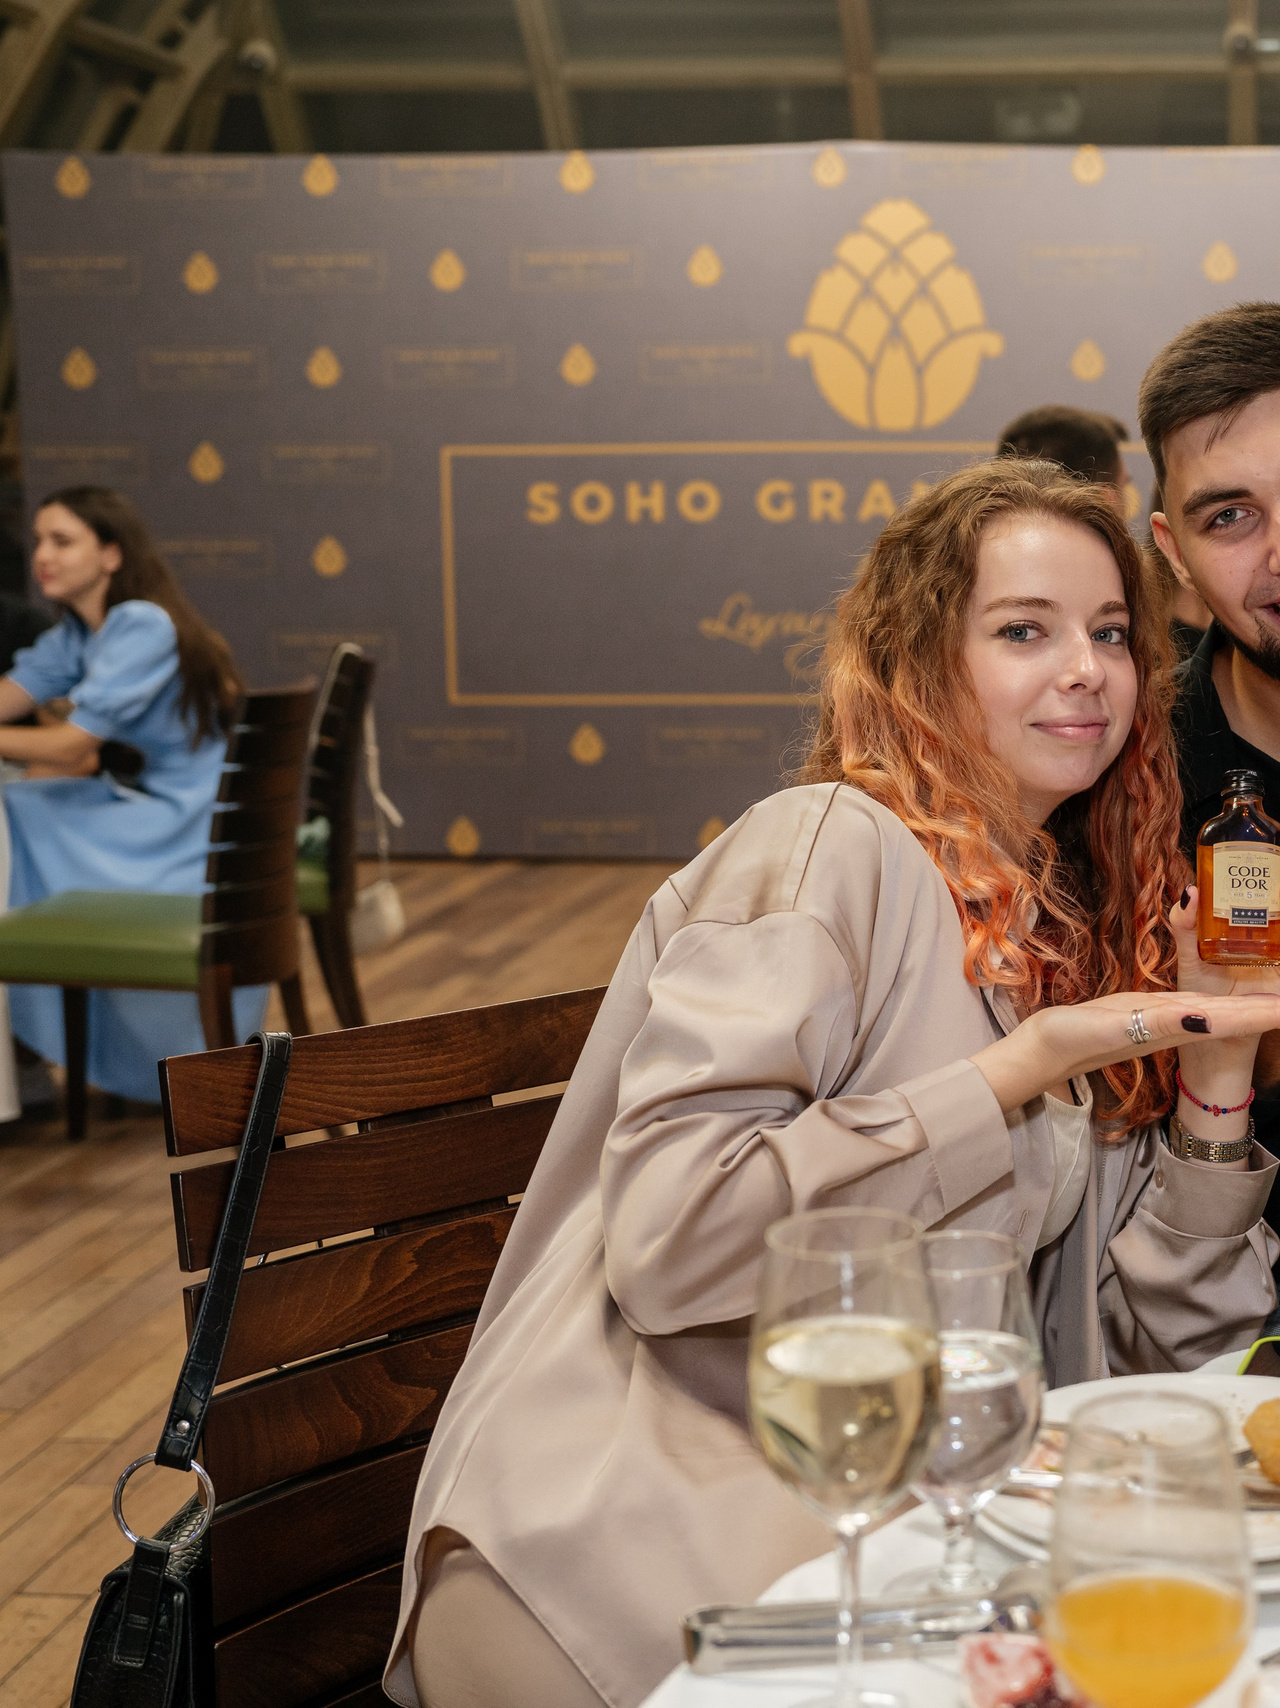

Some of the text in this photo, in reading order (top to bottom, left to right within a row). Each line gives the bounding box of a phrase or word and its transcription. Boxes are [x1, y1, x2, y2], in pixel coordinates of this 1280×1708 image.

[526, 478, 930, 524] SOHO GRA
[1228, 865, 1270, 878] CODE
[1231, 878, 1268, 891] D'OR
[1246, 891, 1253, 900] 5
